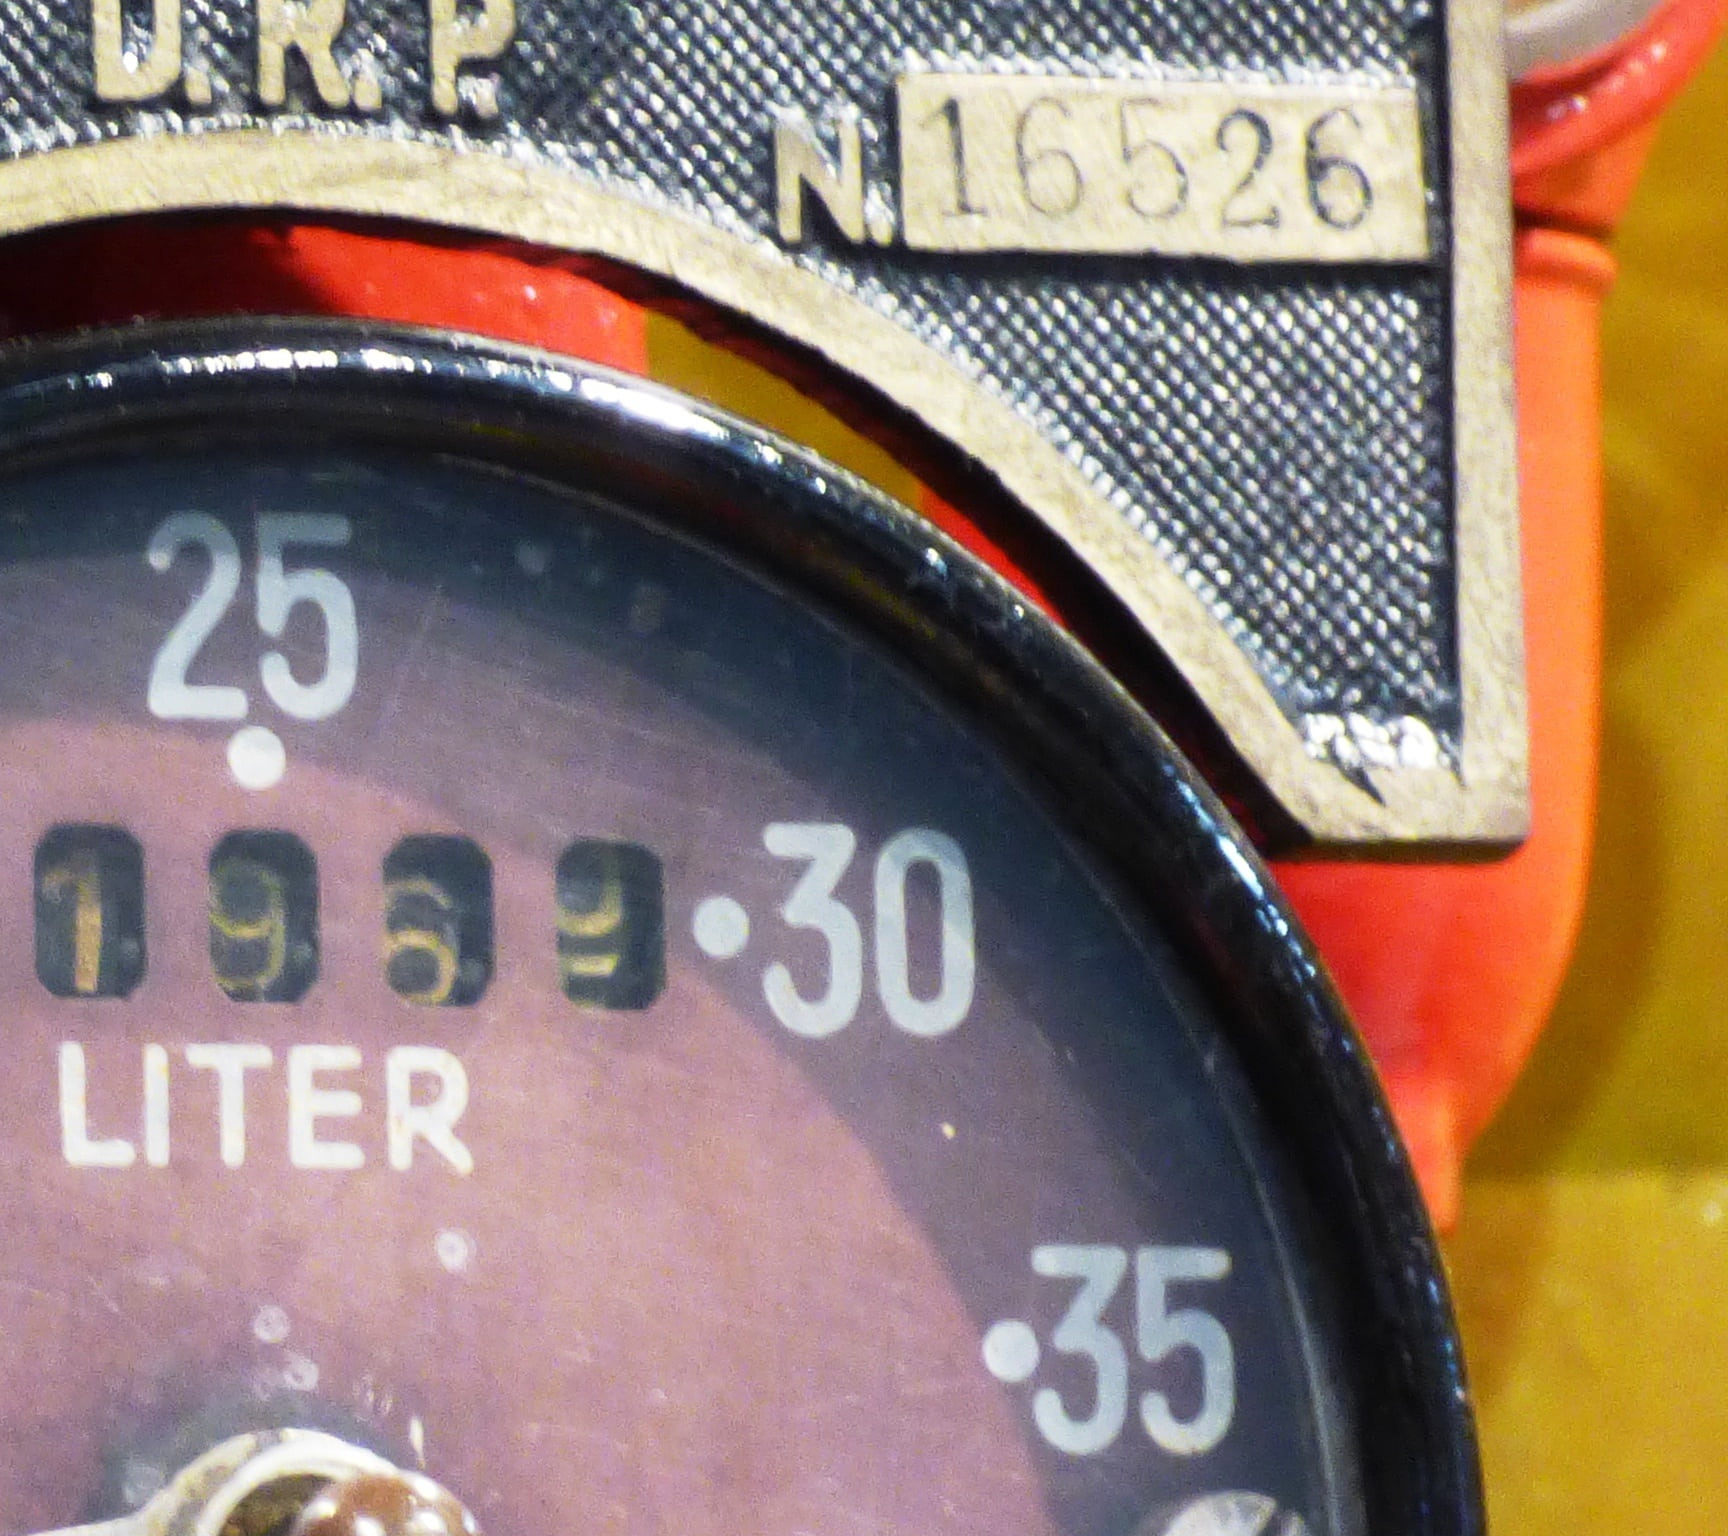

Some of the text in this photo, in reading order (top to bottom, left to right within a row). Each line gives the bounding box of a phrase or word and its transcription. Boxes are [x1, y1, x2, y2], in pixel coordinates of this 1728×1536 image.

[919, 95, 1375, 232] 16526
[146, 509, 360, 720] 25
[762, 821, 977, 1039] 30
[59, 1040, 474, 1176] LITER
[1030, 1244, 1237, 1455] 35
